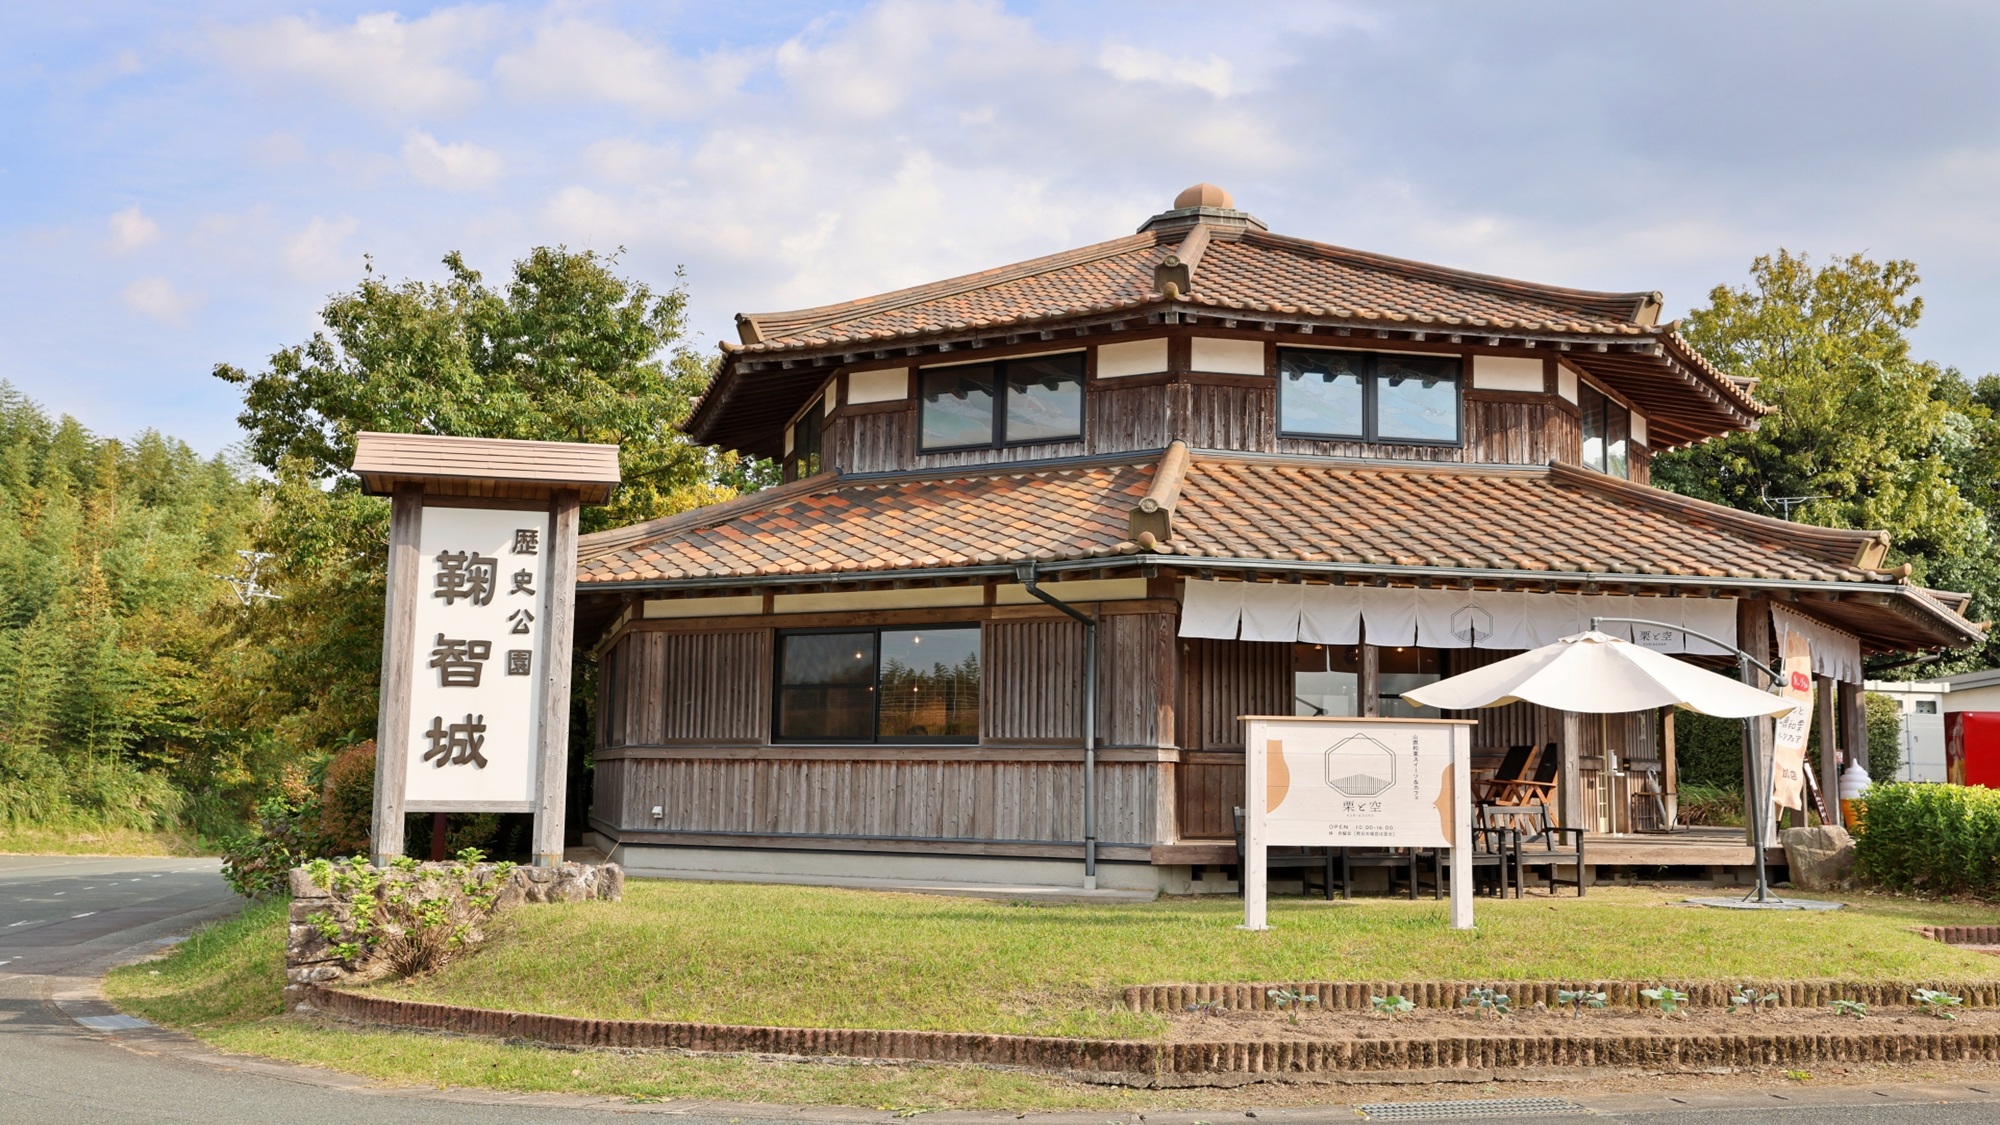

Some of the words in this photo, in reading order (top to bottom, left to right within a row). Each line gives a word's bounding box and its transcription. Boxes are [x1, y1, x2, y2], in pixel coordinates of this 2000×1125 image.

[507, 528, 539, 676] 歴史公園
[1639, 630, 1673, 641] 栗と空
[423, 549, 498, 769] 鞠智城
[1343, 801, 1382, 812] 栗と空
